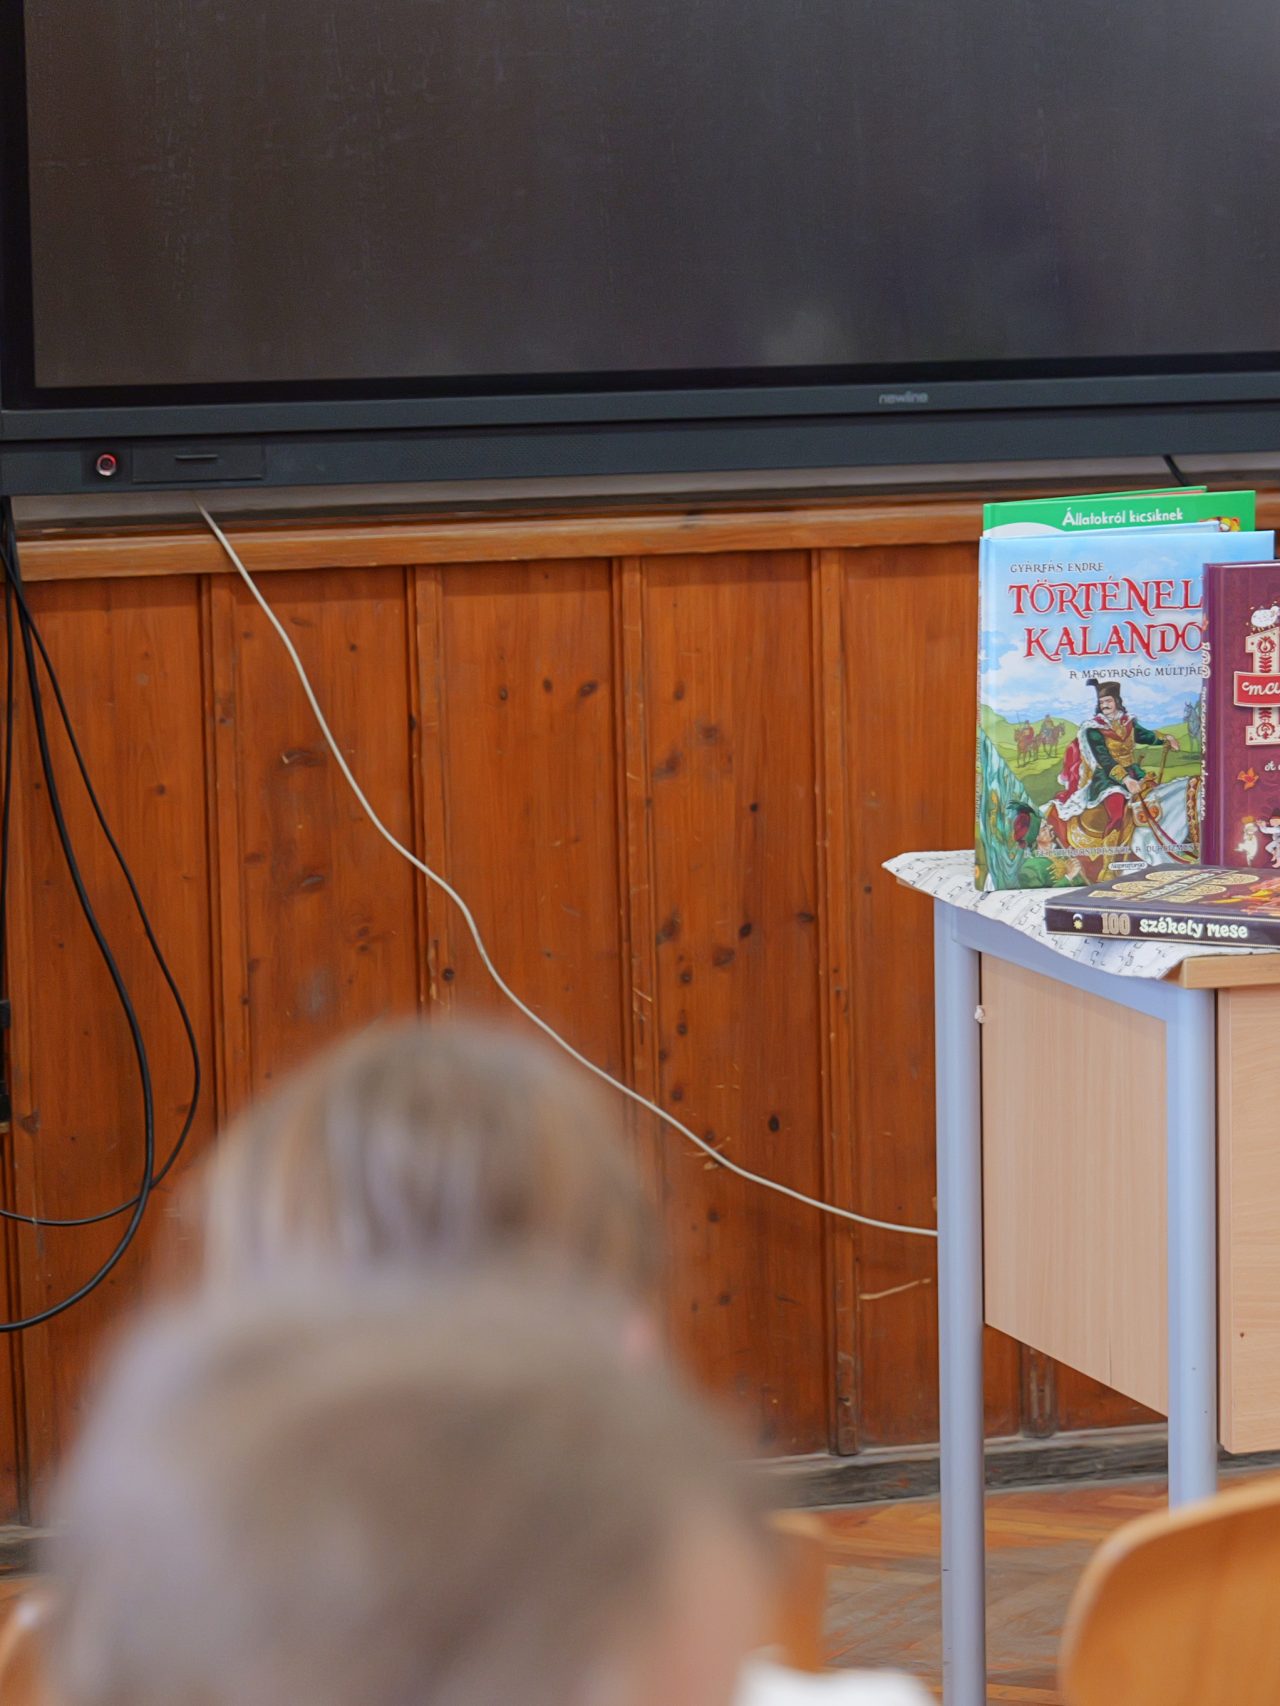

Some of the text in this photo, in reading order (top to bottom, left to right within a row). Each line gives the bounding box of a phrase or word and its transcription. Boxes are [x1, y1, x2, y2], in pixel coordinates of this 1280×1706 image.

[1062, 507, 1183, 526] Állatokról kicsiknek
[1010, 560, 1104, 573] GYÁRFÁS ENDRE
[1069, 670, 1077, 679] A
[1082, 664, 1150, 679] MAGYARSÁG
[1264, 760, 1276, 771] A
[1101, 912, 1249, 939] 100 székely mese
